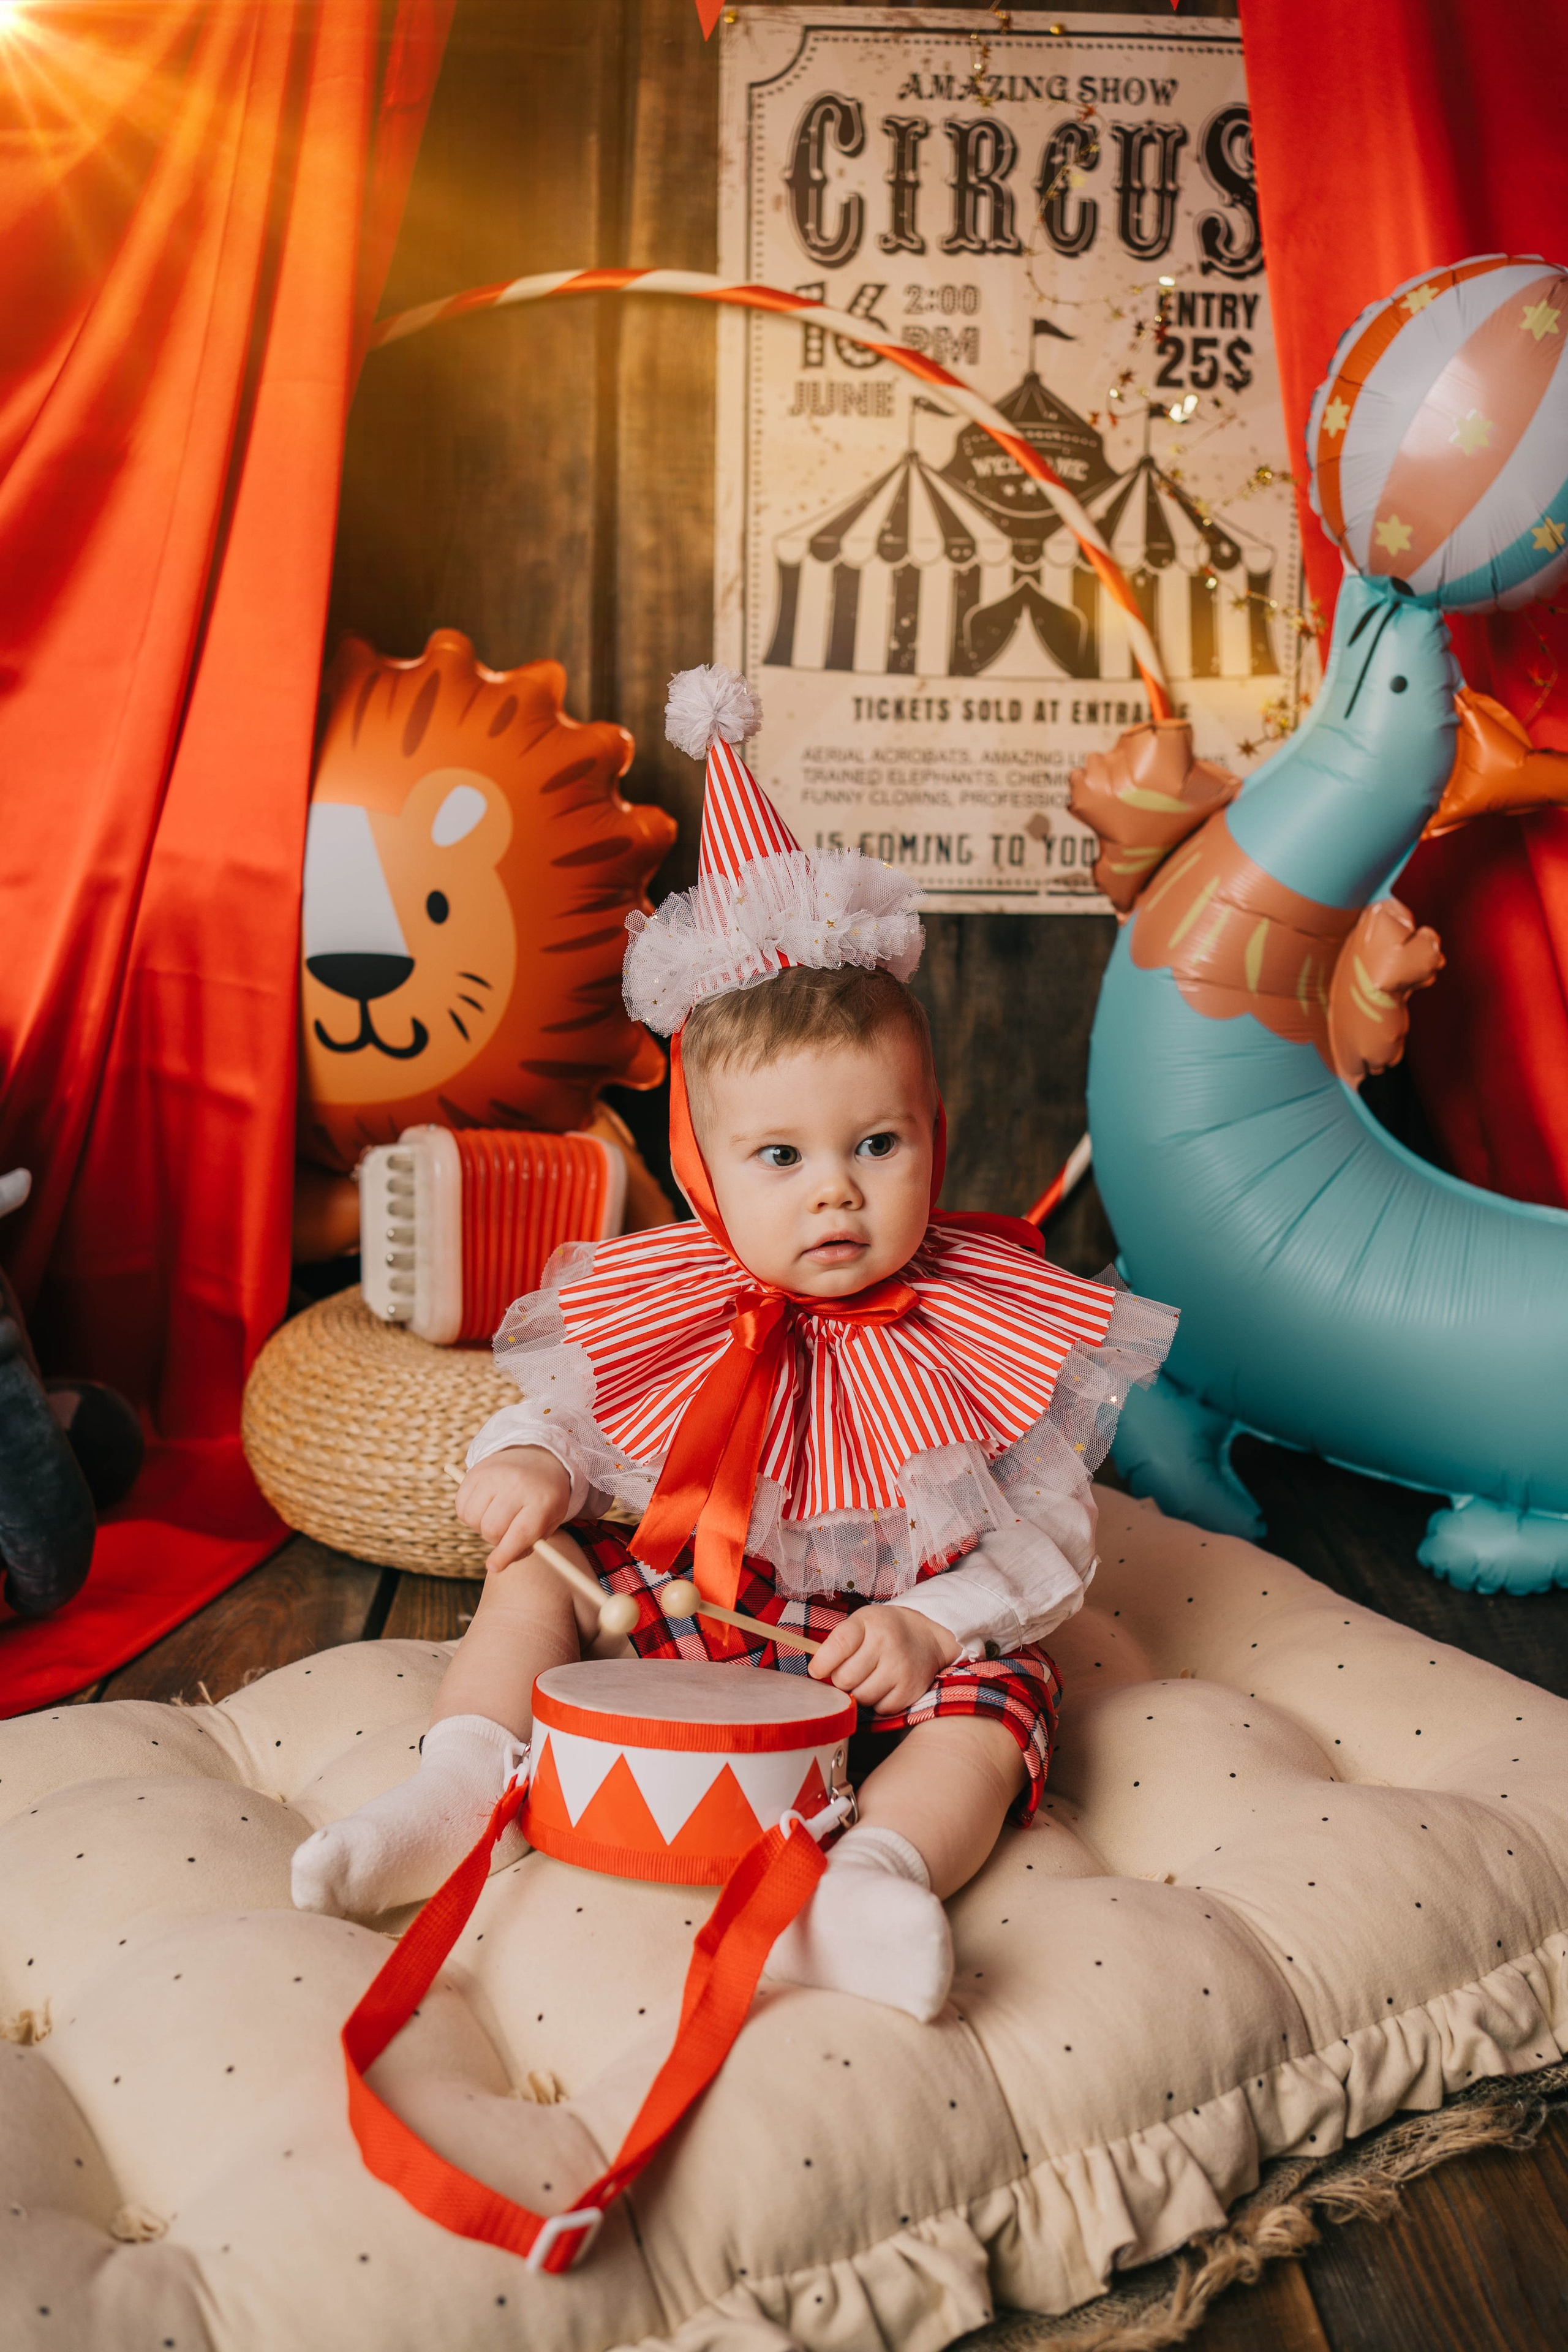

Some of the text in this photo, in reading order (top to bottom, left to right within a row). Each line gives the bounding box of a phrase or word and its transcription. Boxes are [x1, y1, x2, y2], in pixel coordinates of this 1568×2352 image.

[897, 74, 1179, 107] AMAZING SHOW
[783, 90, 1266, 281] CIRCUS
[904, 284, 981, 315] 2:00
[1156, 290, 1259, 330] ENTRY
[794, 281, 890, 369] 16
[902, 325, 979, 366] PM
[1155, 335, 1253, 394] 25$
[787, 380, 894, 418] JUNE
[971, 454, 1089, 482] WELME
[853, 696, 950, 722] TICKETS
[962, 698, 1022, 723] SOLD
[1033, 698, 1060, 723] AT
[801, 746, 864, 764] AERIAL
[981, 748, 1064, 766] AMAZING
[803, 767, 884, 786] TRAINED
[801, 787, 864, 805] FUNNY
[859, 831, 973, 865] COMING
[991, 834, 1025, 866] TO
[1042, 835, 1097, 867] YOU
